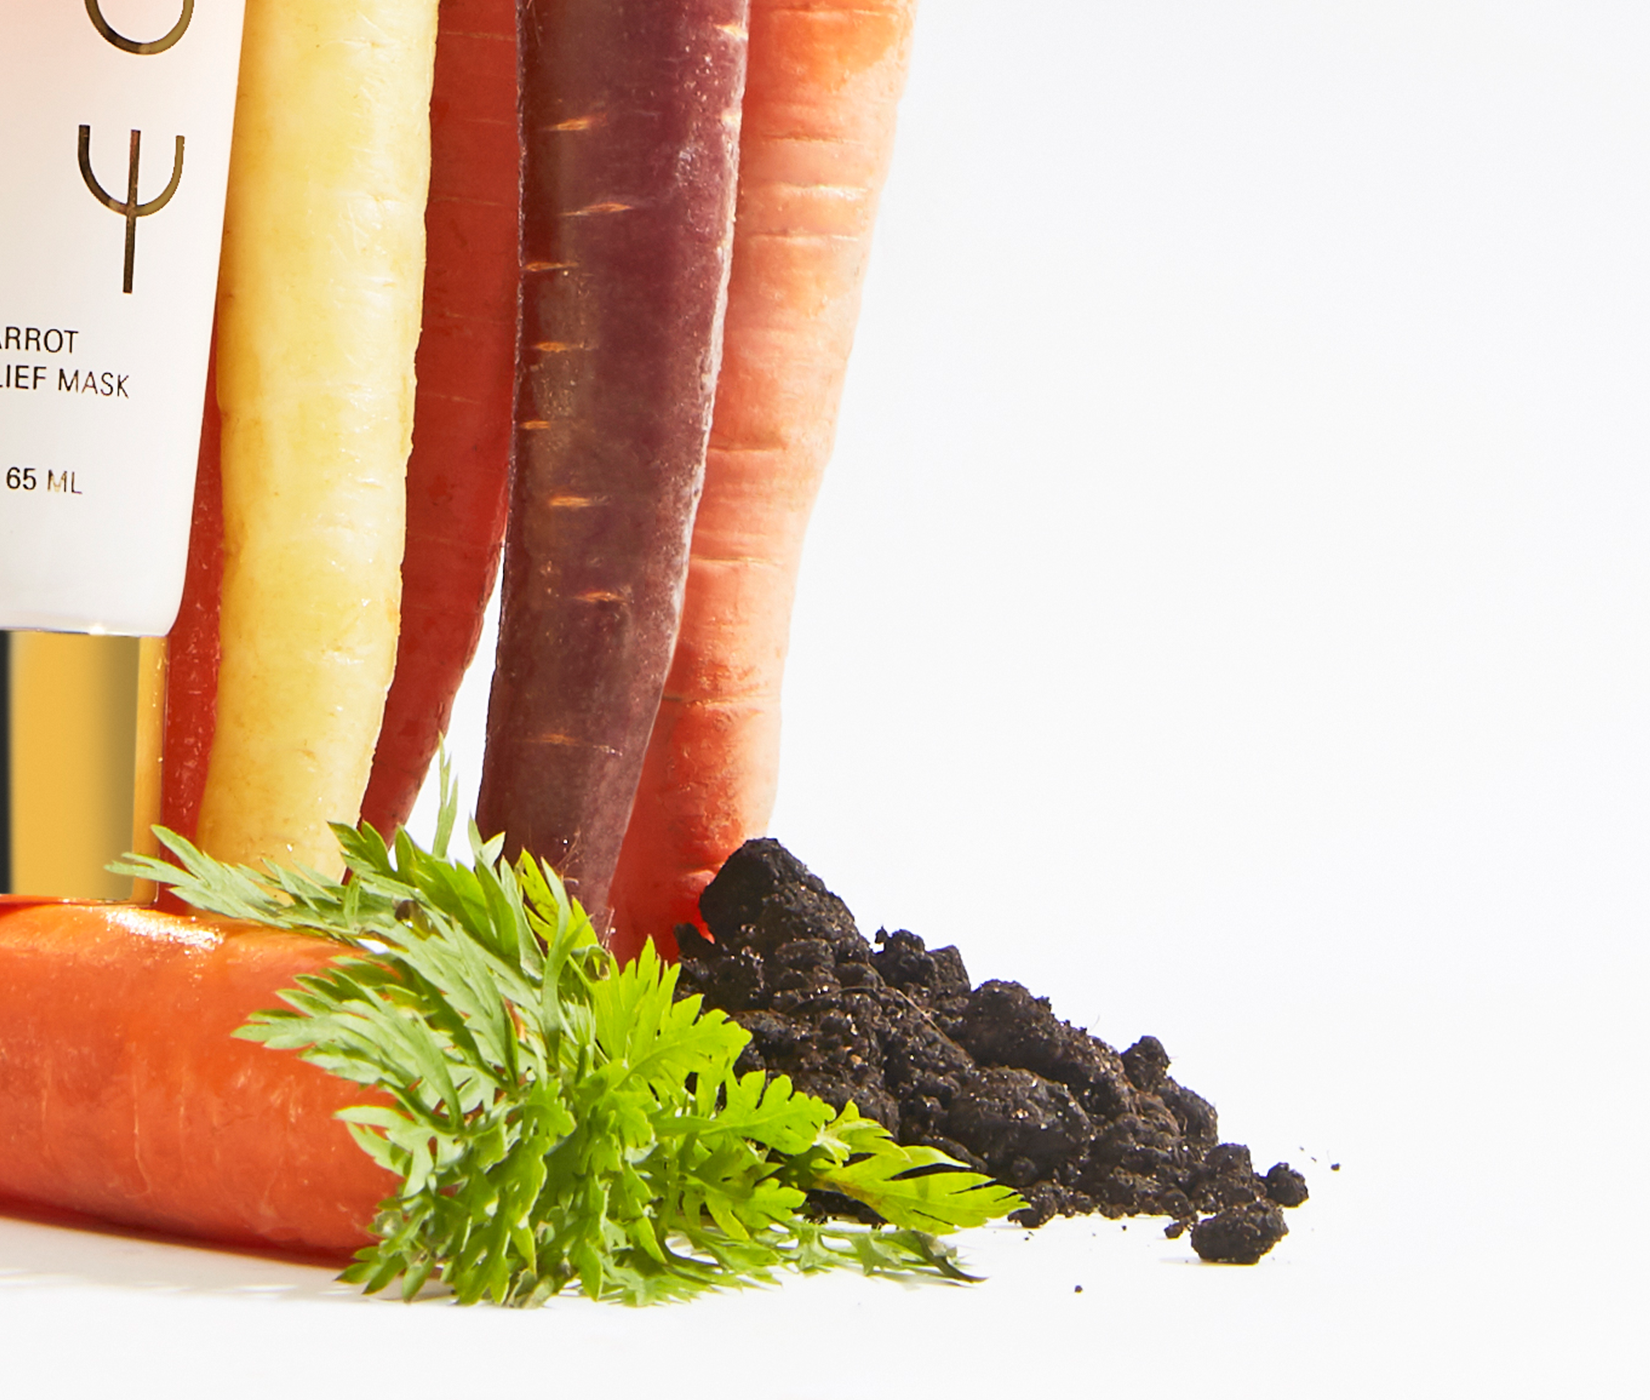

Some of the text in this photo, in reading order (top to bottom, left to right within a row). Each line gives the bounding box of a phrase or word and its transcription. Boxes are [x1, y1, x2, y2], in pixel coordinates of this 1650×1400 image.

[58, 368, 130, 399] MASK
[6, 466, 37, 491] 65
[47, 469, 83, 495] ML
